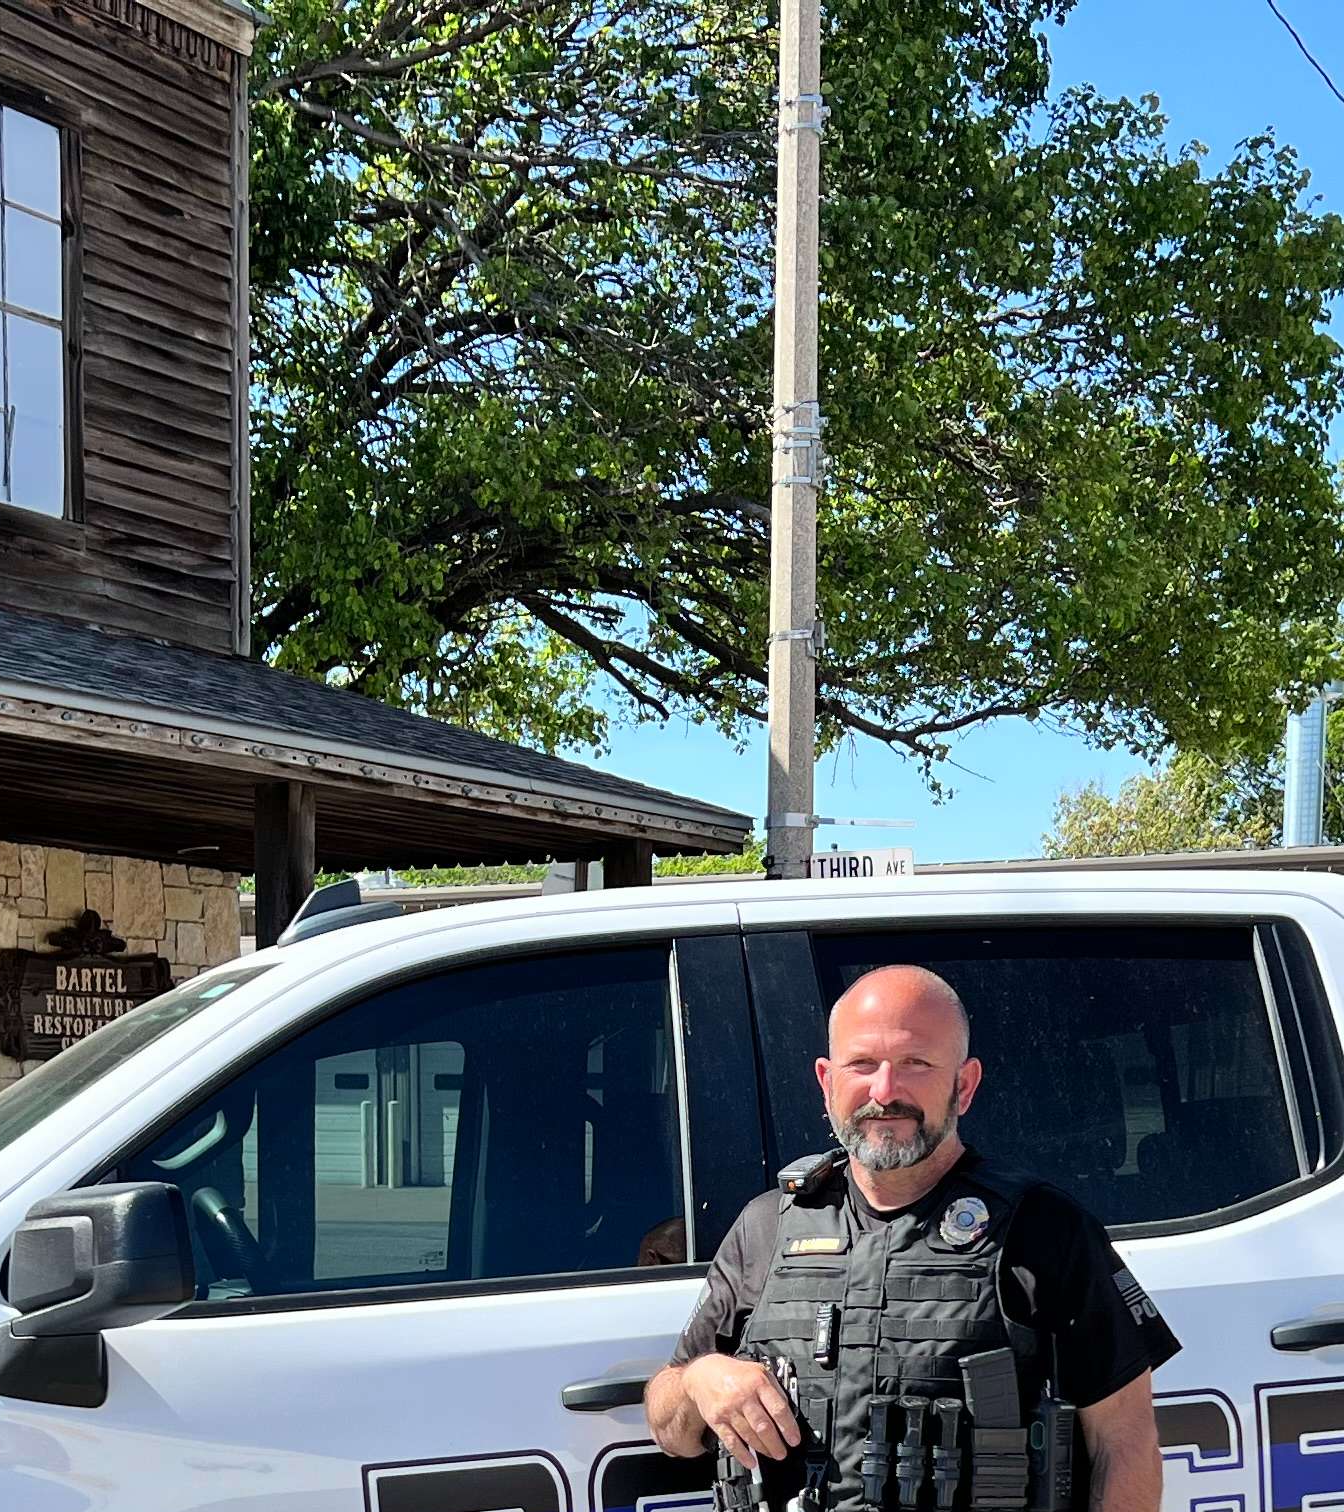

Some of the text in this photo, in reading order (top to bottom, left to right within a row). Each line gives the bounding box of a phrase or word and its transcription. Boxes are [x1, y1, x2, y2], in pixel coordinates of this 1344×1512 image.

[817, 856, 906, 878] THIRD AVE
[56, 966, 127, 993] BARTEL
